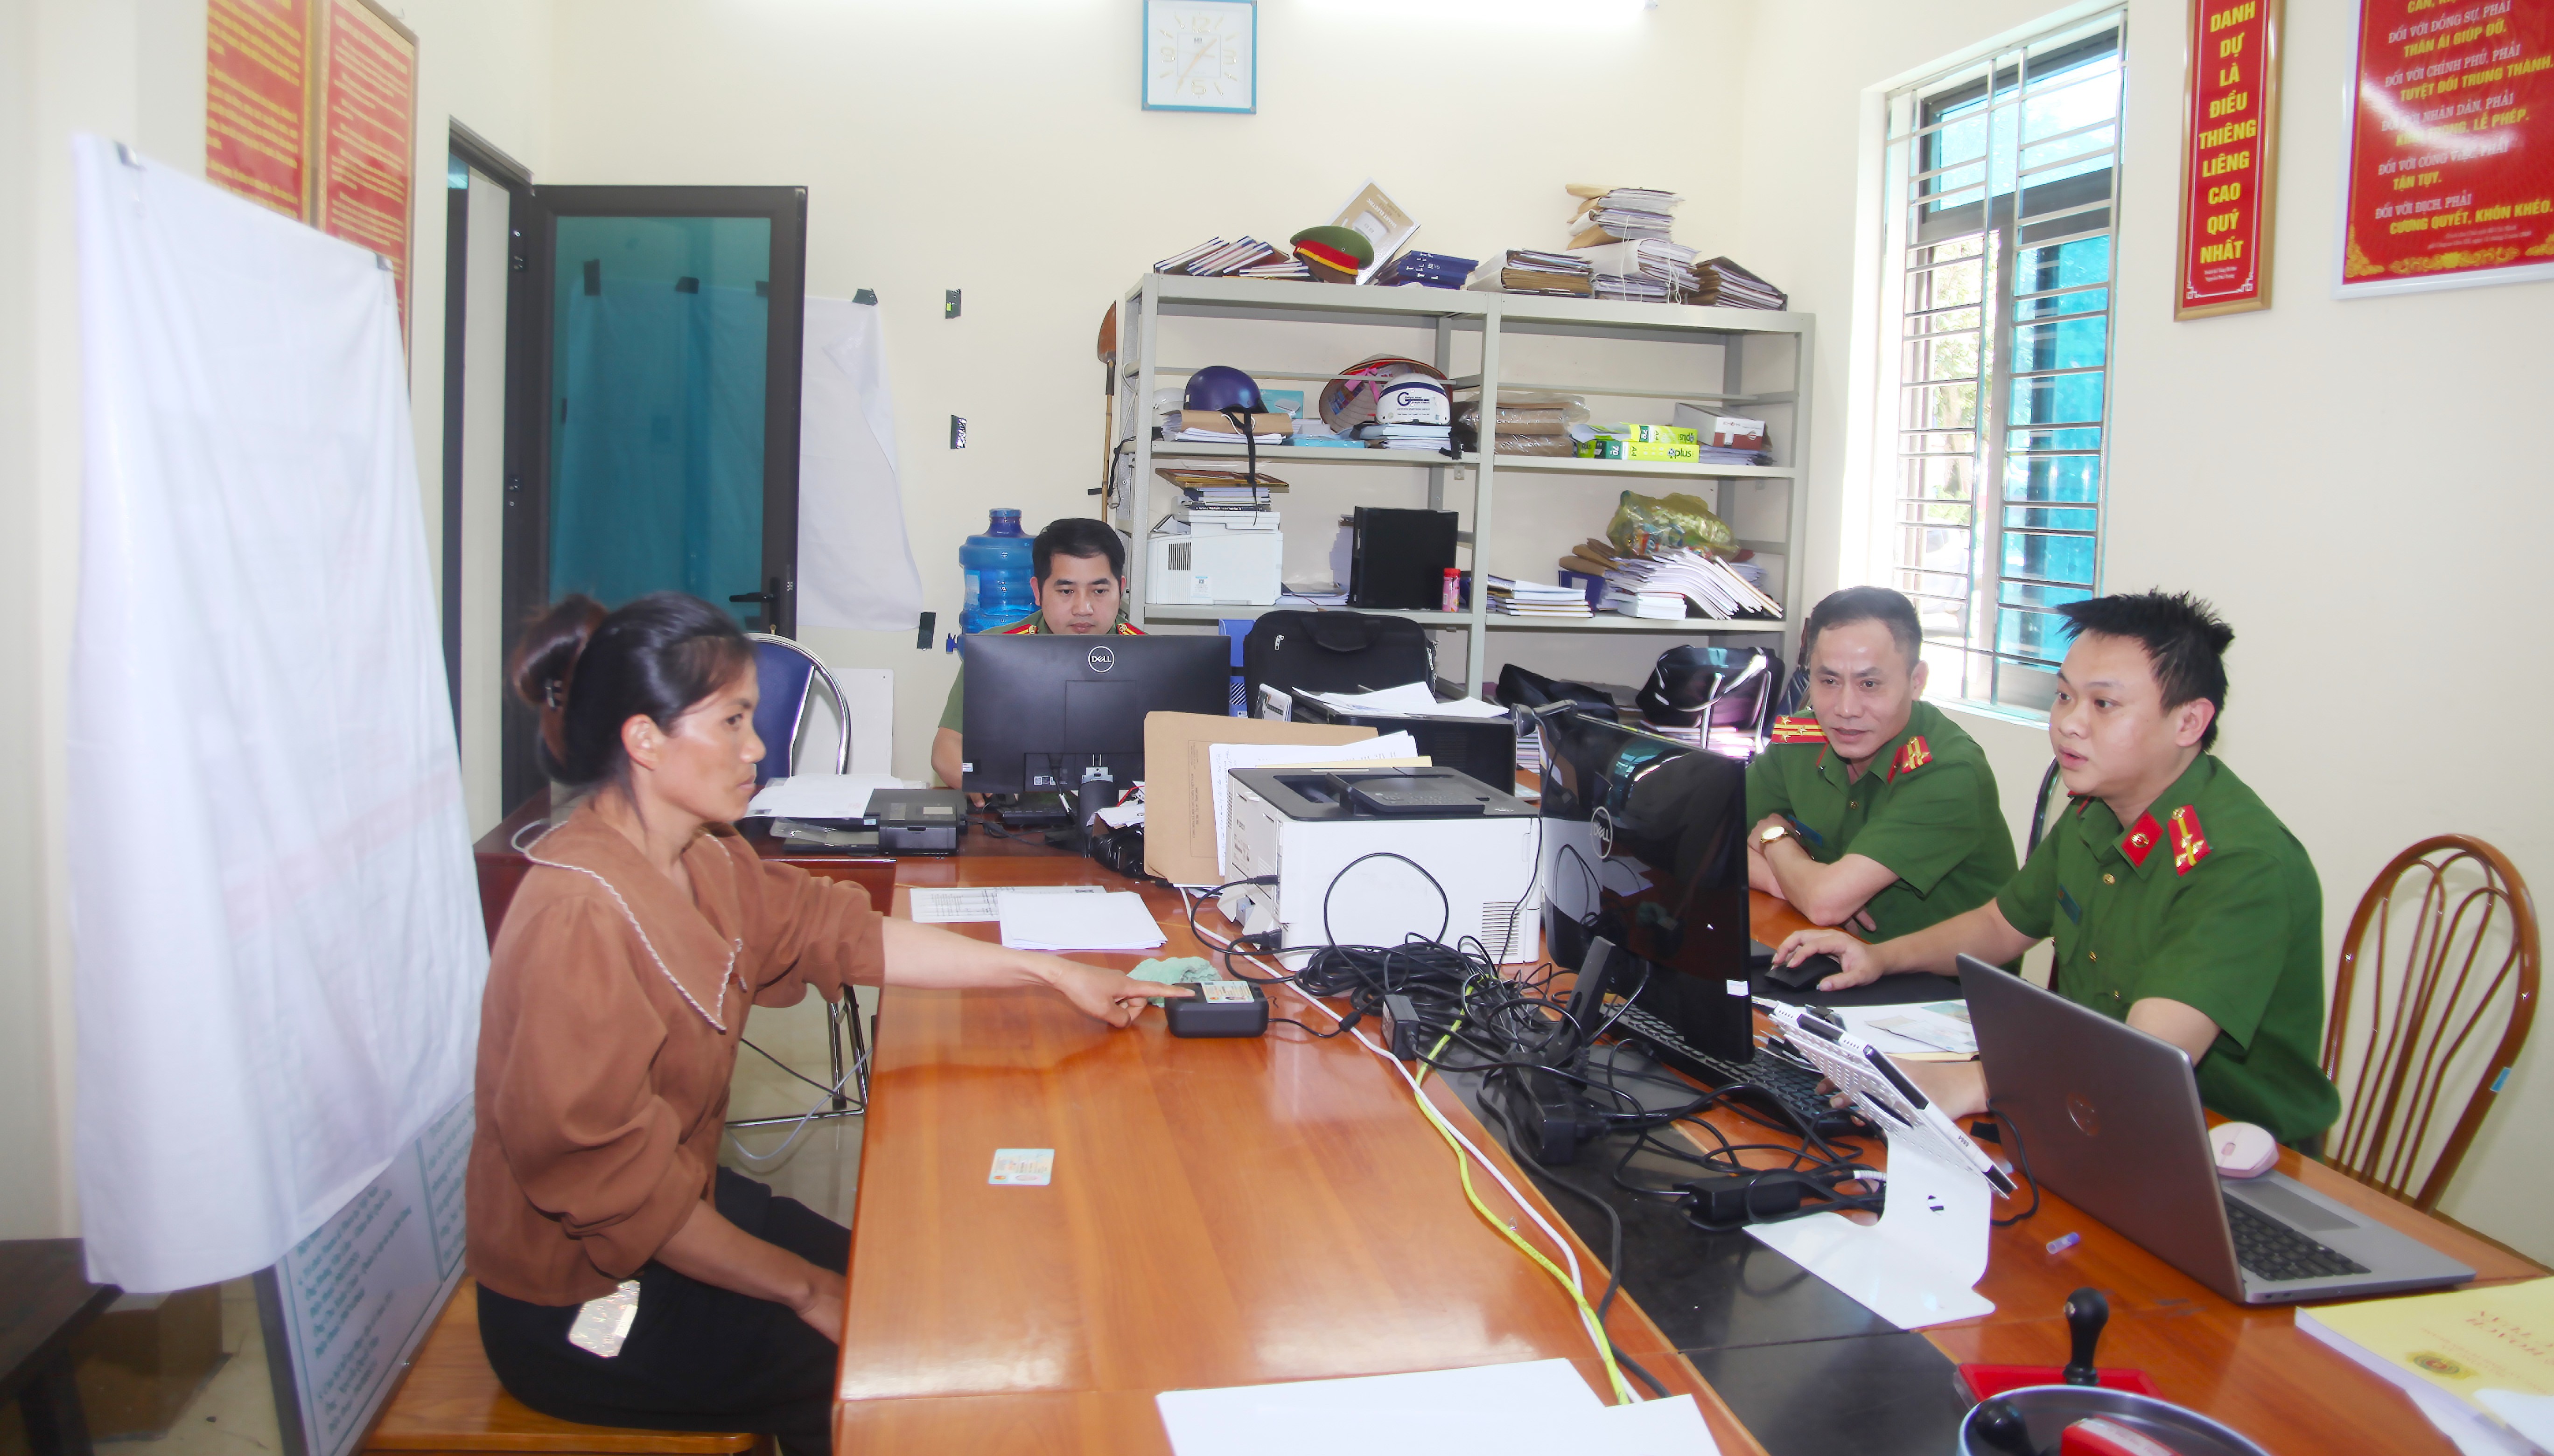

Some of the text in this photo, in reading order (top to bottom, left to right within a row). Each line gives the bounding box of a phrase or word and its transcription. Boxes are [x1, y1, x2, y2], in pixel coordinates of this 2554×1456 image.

[2210, 1, 2255, 32] DANH
[2389, 24, 2406, 43] ĐỐI
[2410, 20, 2428, 37] VỚI
[2453, 26, 2483, 45] GIÚP
[2220, 32, 2245, 58] DỰ
[2219, 63, 2240, 87] LÀ
[2385, 68, 2403, 87] ĐỐI
[2406, 63, 2424, 82] VỚI
[2462, 68, 2503, 89] TRUNG
[2209, 90, 2248, 118] ĐIỀU
[2199, 119, 2257, 149] THIÊNG
[2202, 151, 2250, 178] LIÊNG
[2208, 182, 2241, 205] CAO
[2393, 174, 2415, 192] TẬN
[2375, 202, 2393, 219] ĐỐI
[2445, 189, 2472, 209] PHẢI
[2475, 204, 2511, 223] KHÔN
[2207, 208, 2240, 235] QUÝ
[2200, 236, 2244, 264] NHẤT
[1612, 445, 1620, 456] 70
[1631, 446, 1637, 457] A4
[1593, 823, 1610, 842] DELL
